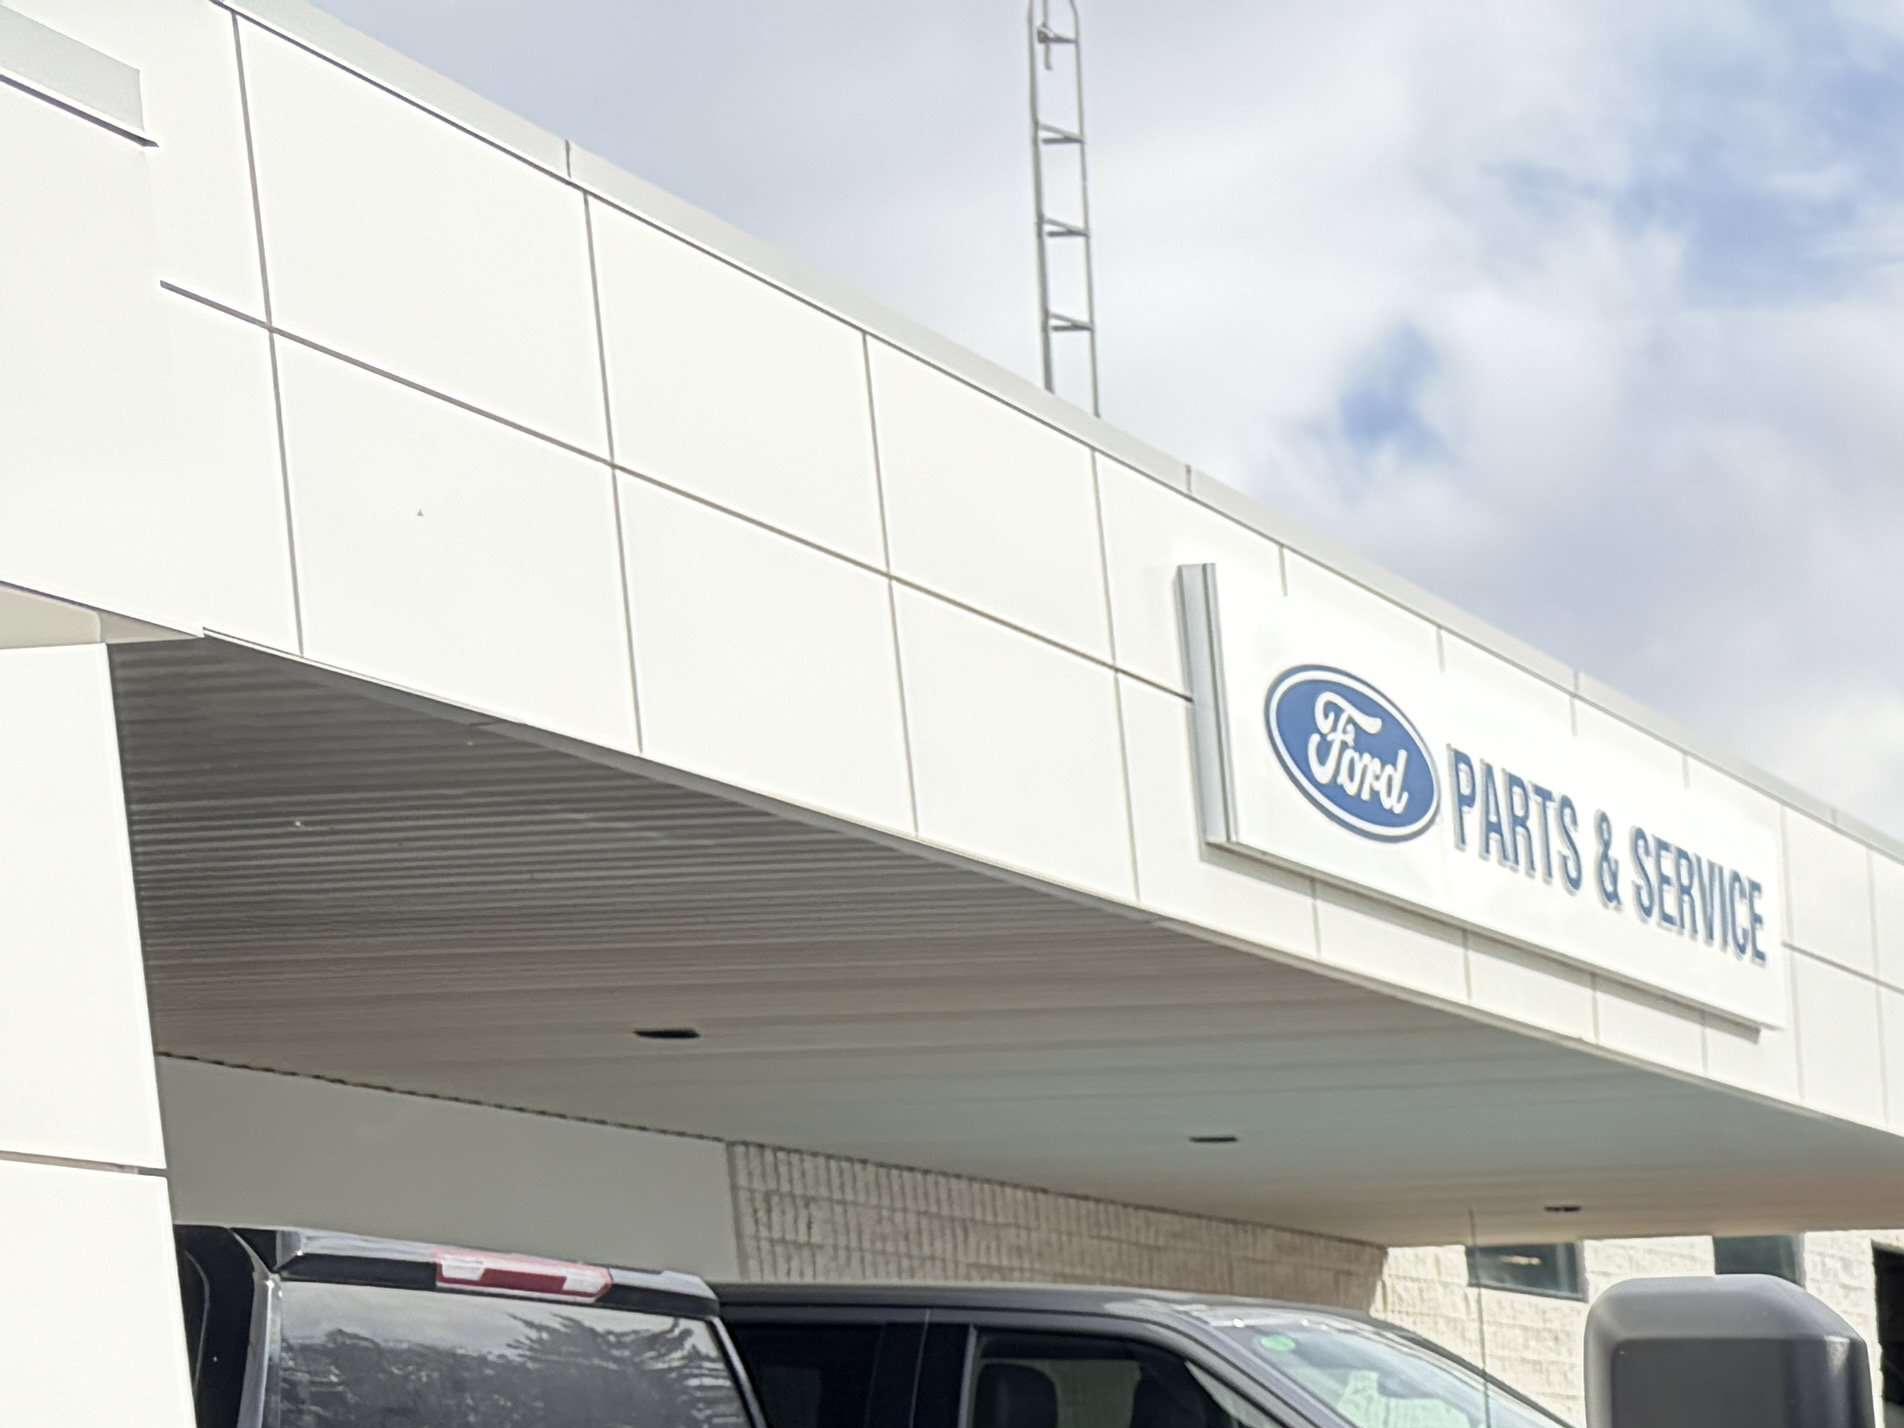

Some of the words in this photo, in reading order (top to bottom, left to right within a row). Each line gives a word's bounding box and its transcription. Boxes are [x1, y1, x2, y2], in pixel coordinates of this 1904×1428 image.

[1307, 691, 1409, 814] Ford
[1446, 743, 1583, 892] PARTS
[1594, 809, 1623, 907] &
[1630, 825, 1768, 966] SERVICE
